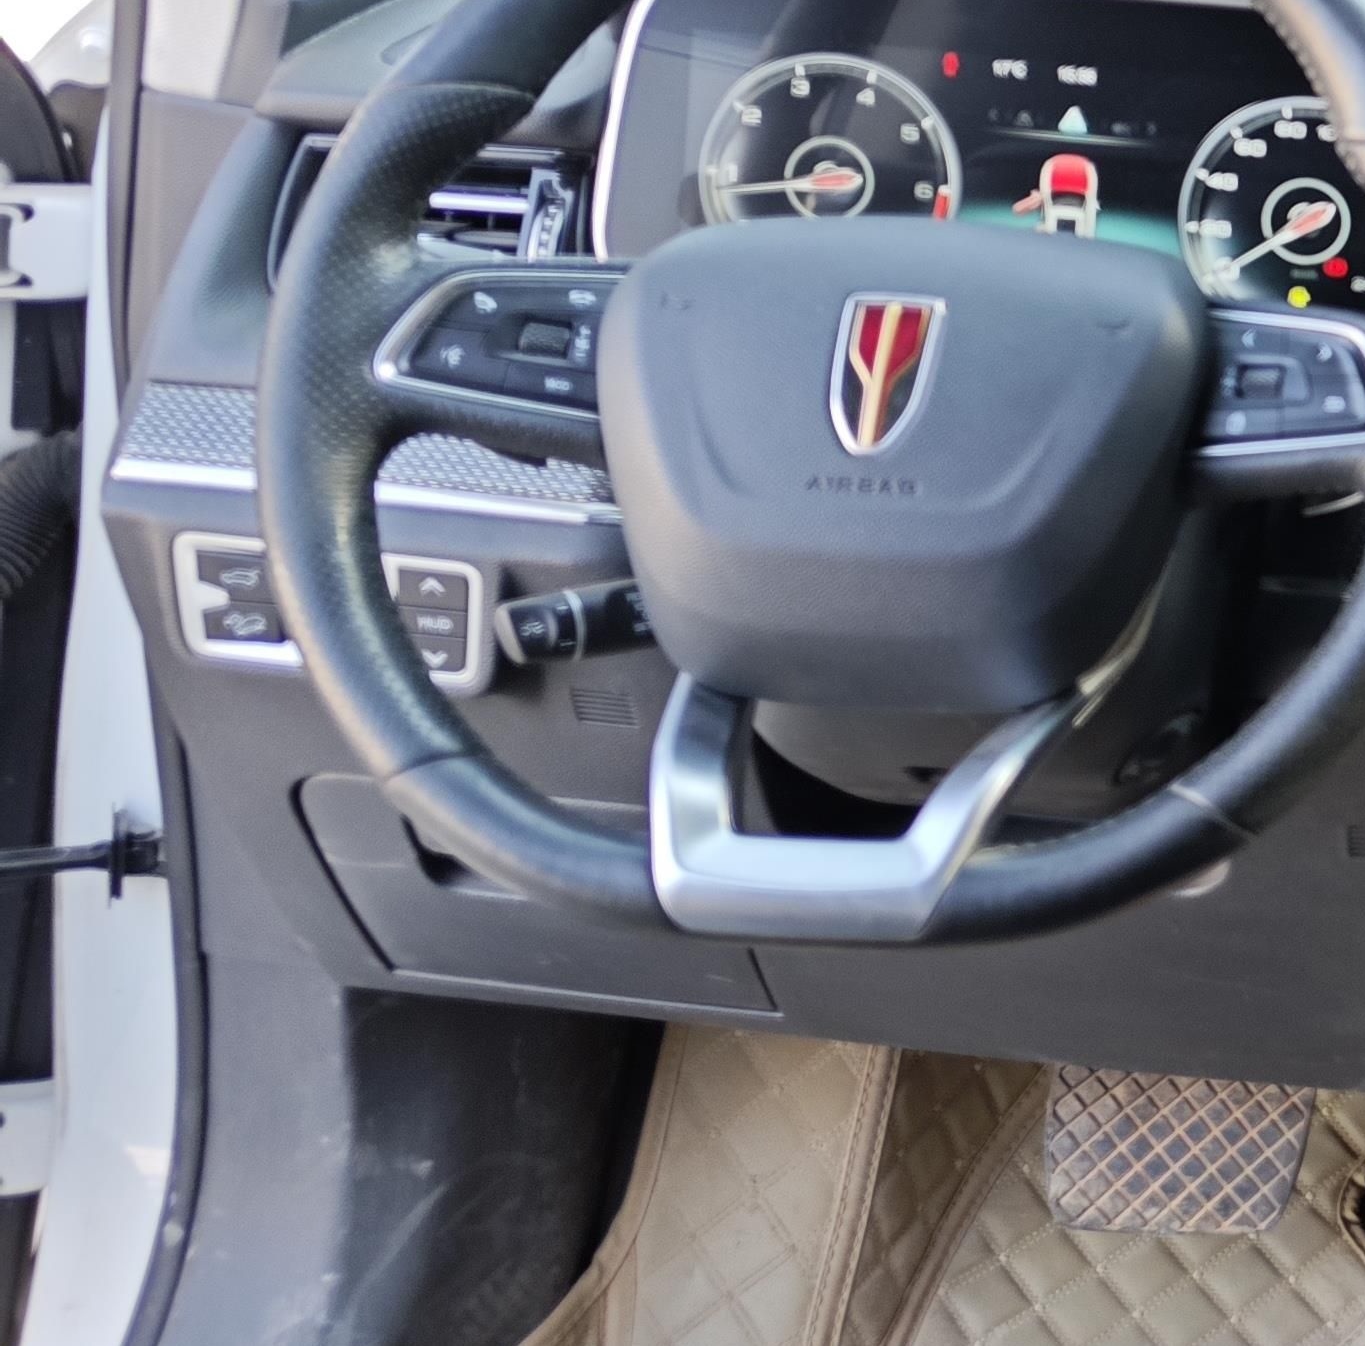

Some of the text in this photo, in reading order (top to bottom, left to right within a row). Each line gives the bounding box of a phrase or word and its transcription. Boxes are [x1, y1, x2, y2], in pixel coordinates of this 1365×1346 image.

[790, 76, 810, 97] 3
[856, 87, 876, 106] 4
[901, 123, 921, 144] 5
[914, 180, 934, 201] 6
[805, 475, 918, 496] AIRBAG
[416, 614, 454, 632] HUD
